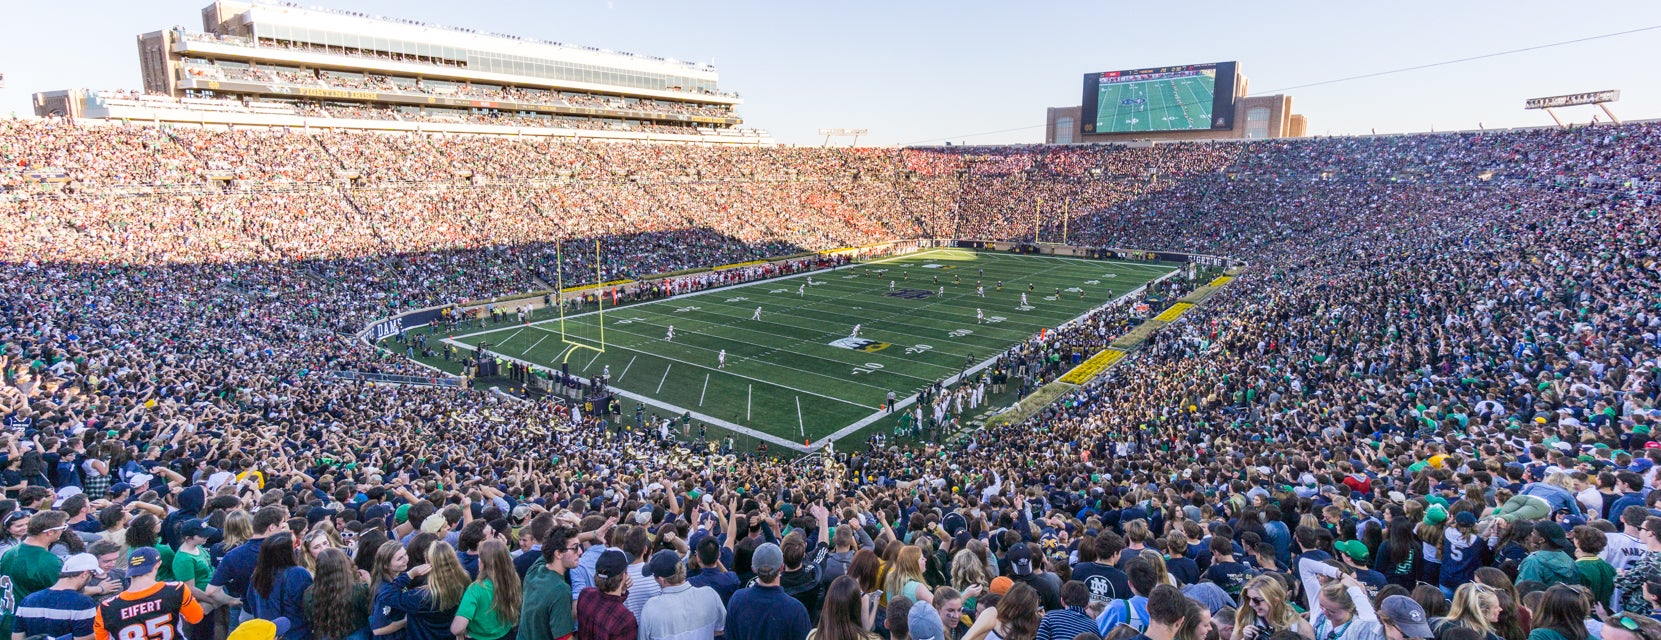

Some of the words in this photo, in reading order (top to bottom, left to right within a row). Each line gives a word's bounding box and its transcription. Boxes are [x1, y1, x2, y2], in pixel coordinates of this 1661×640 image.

[905, 344, 934, 355] 20
[851, 362, 885, 375] 10
[120, 599, 162, 620] EIFERT
